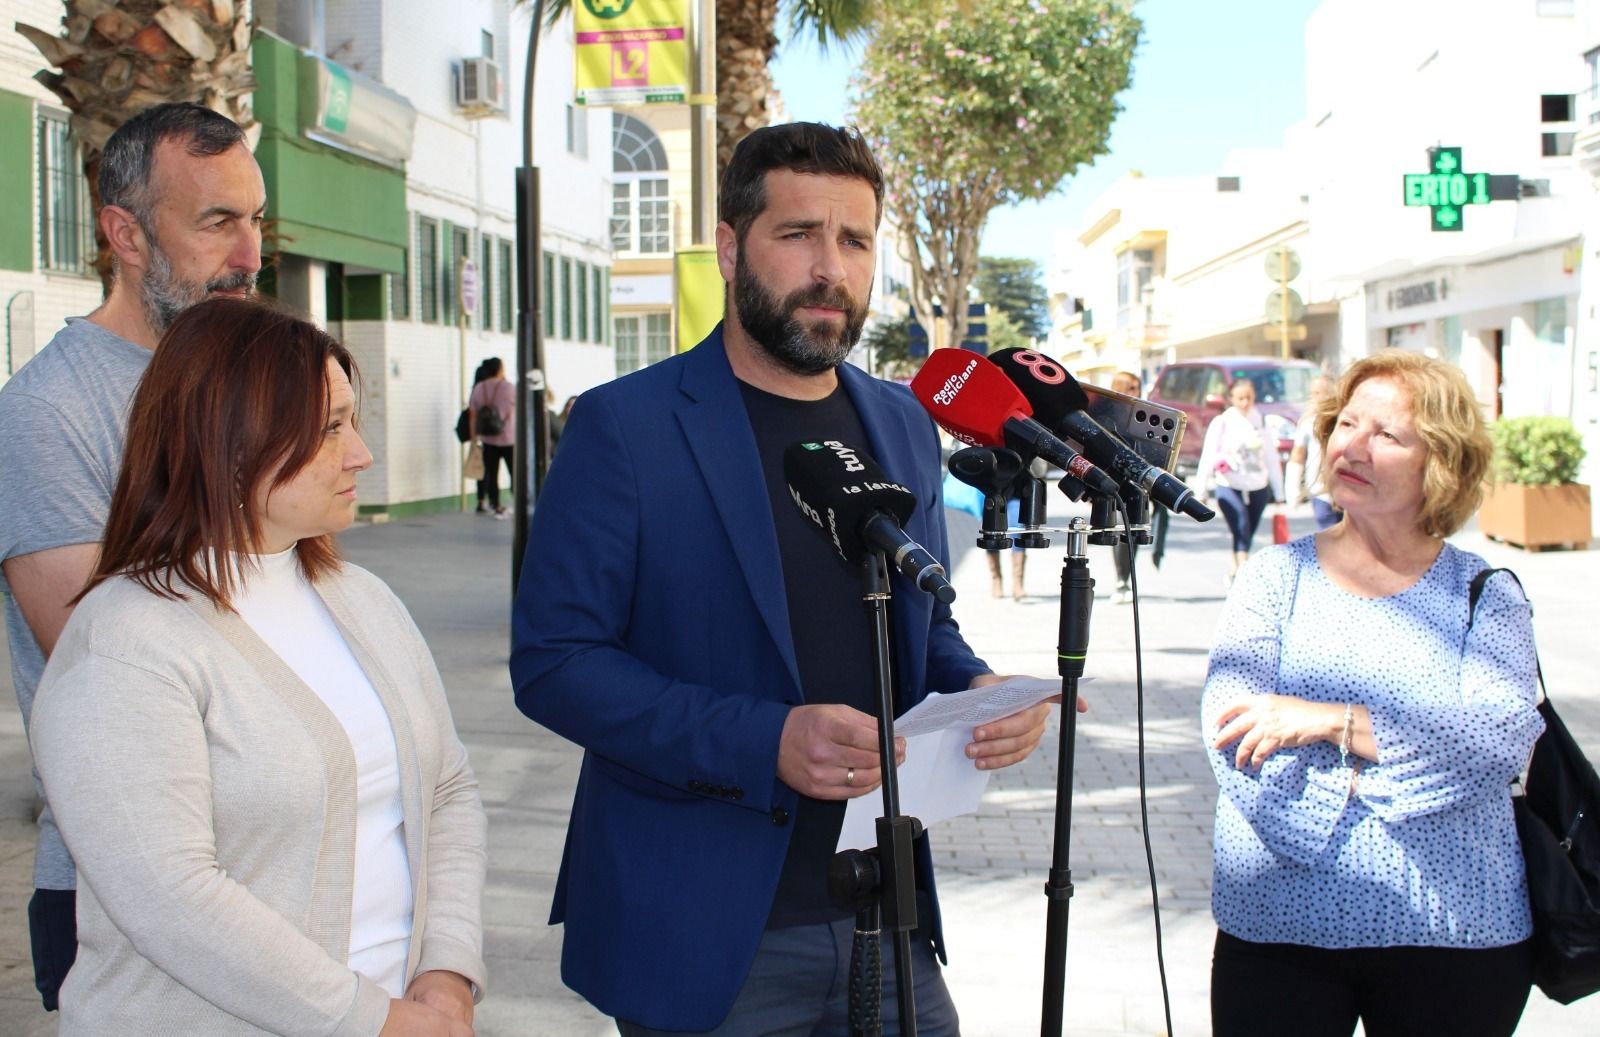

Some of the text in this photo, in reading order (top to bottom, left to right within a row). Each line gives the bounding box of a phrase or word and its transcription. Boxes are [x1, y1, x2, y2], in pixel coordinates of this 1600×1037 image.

[613, 49, 645, 80] L2
[1405, 173, 1489, 206] ERTO 1
[942, 359, 978, 406] Chiclana
[1012, 350, 1066, 385] 8
[933, 374, 957, 405] Radio
[823, 440, 865, 472] tuya
[842, 485, 862, 494] la
